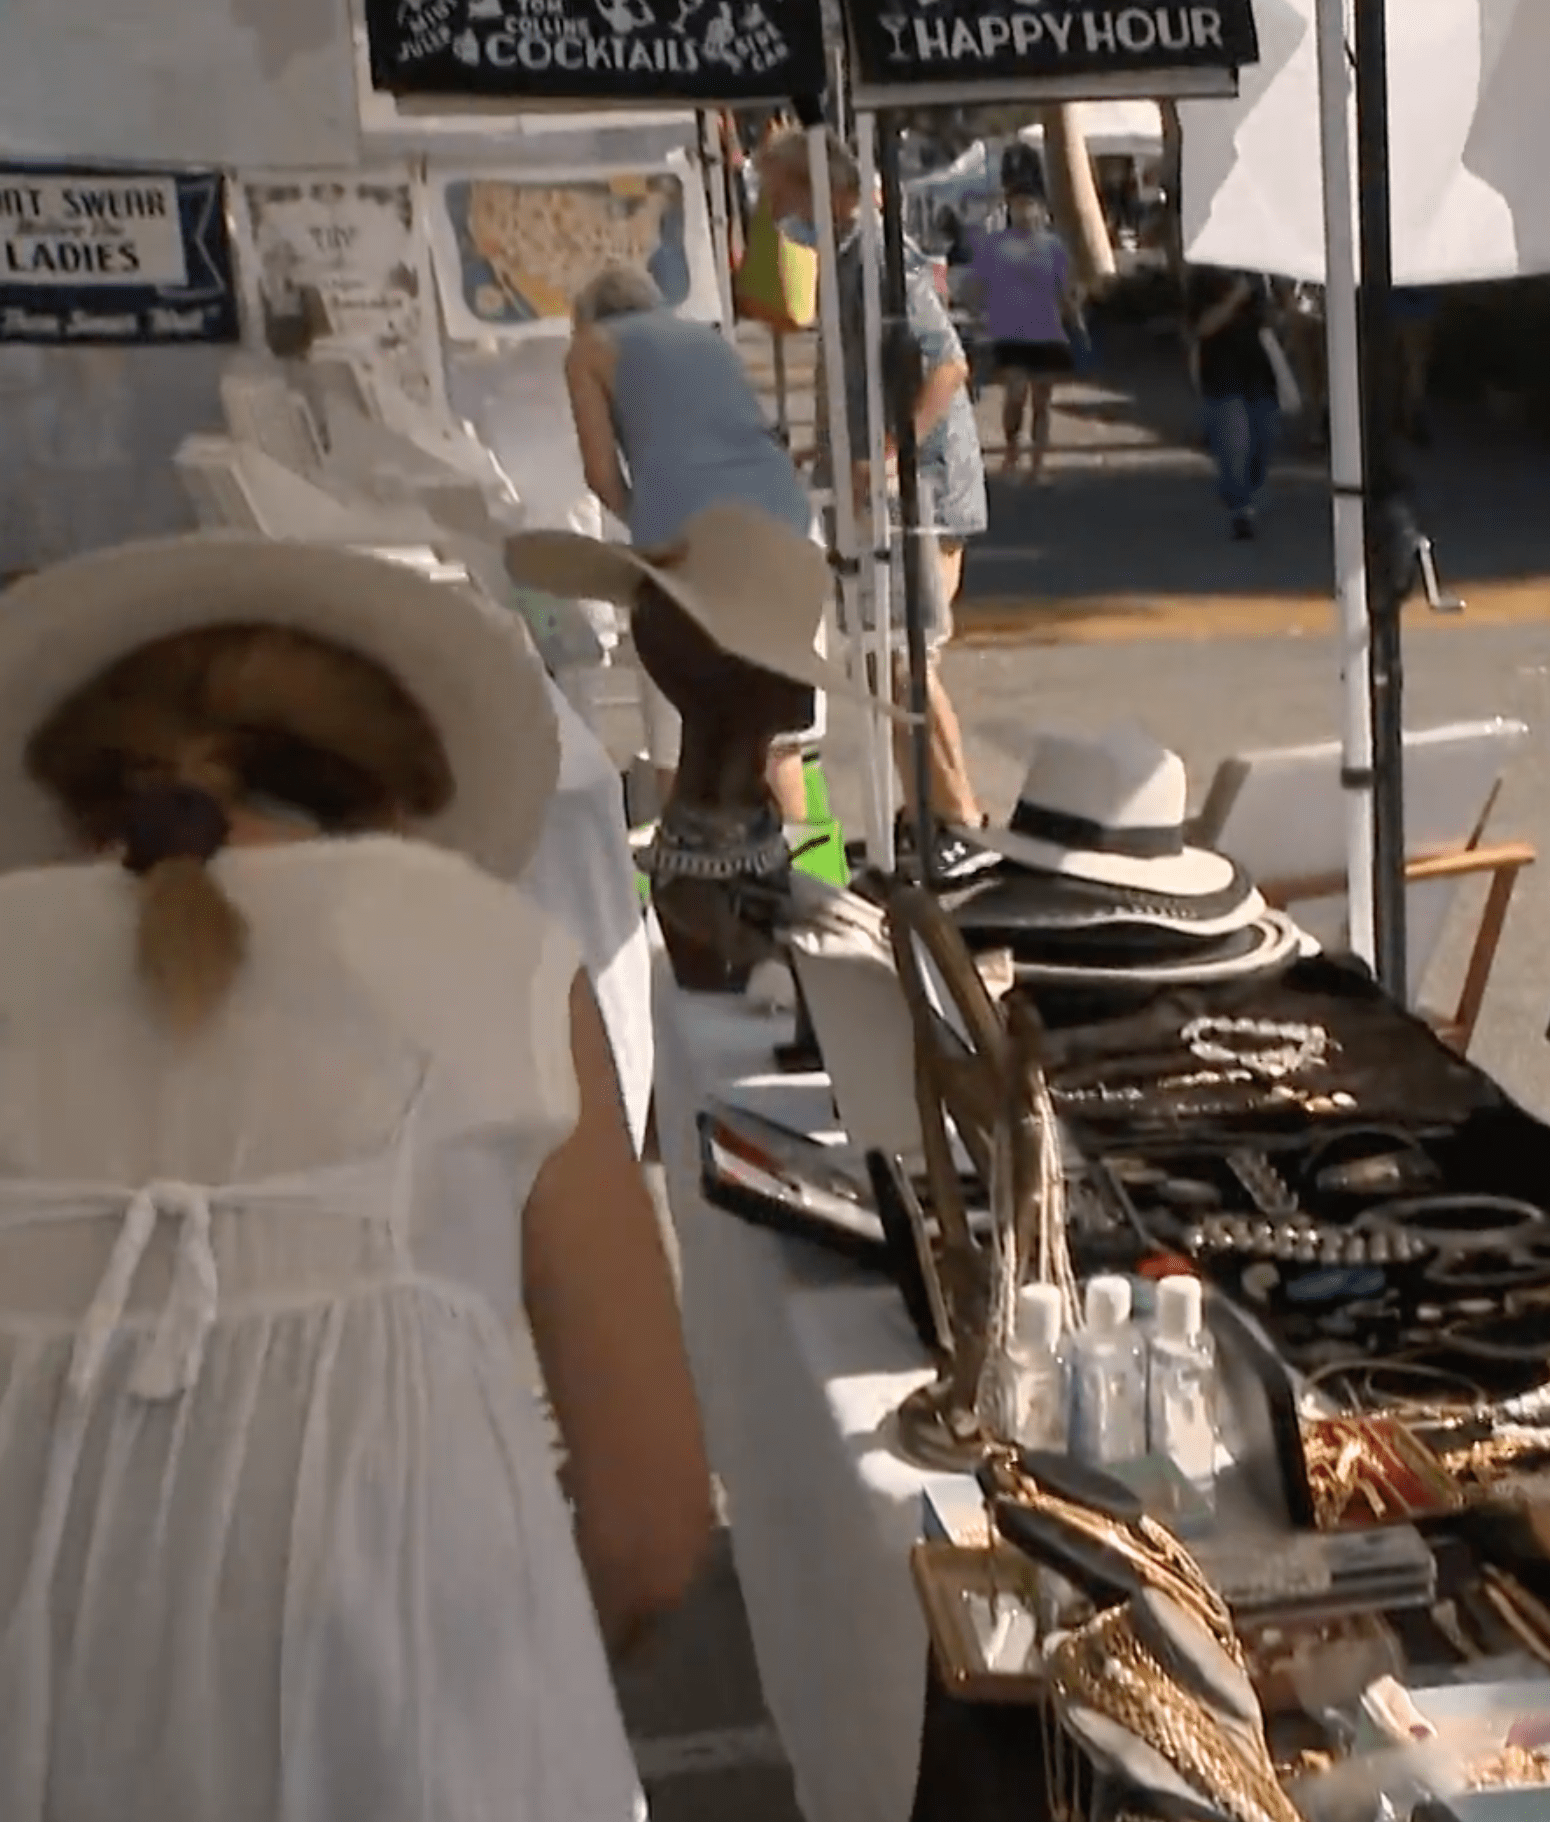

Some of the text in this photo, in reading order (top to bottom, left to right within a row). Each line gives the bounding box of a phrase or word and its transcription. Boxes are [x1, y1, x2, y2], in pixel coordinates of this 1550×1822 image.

[486, 31, 698, 72] COCKTAILS
[912, 8, 1222, 60] HAPPY HOUR
[61, 188, 167, 219] SWEAR
[6, 240, 140, 273] LADIES
